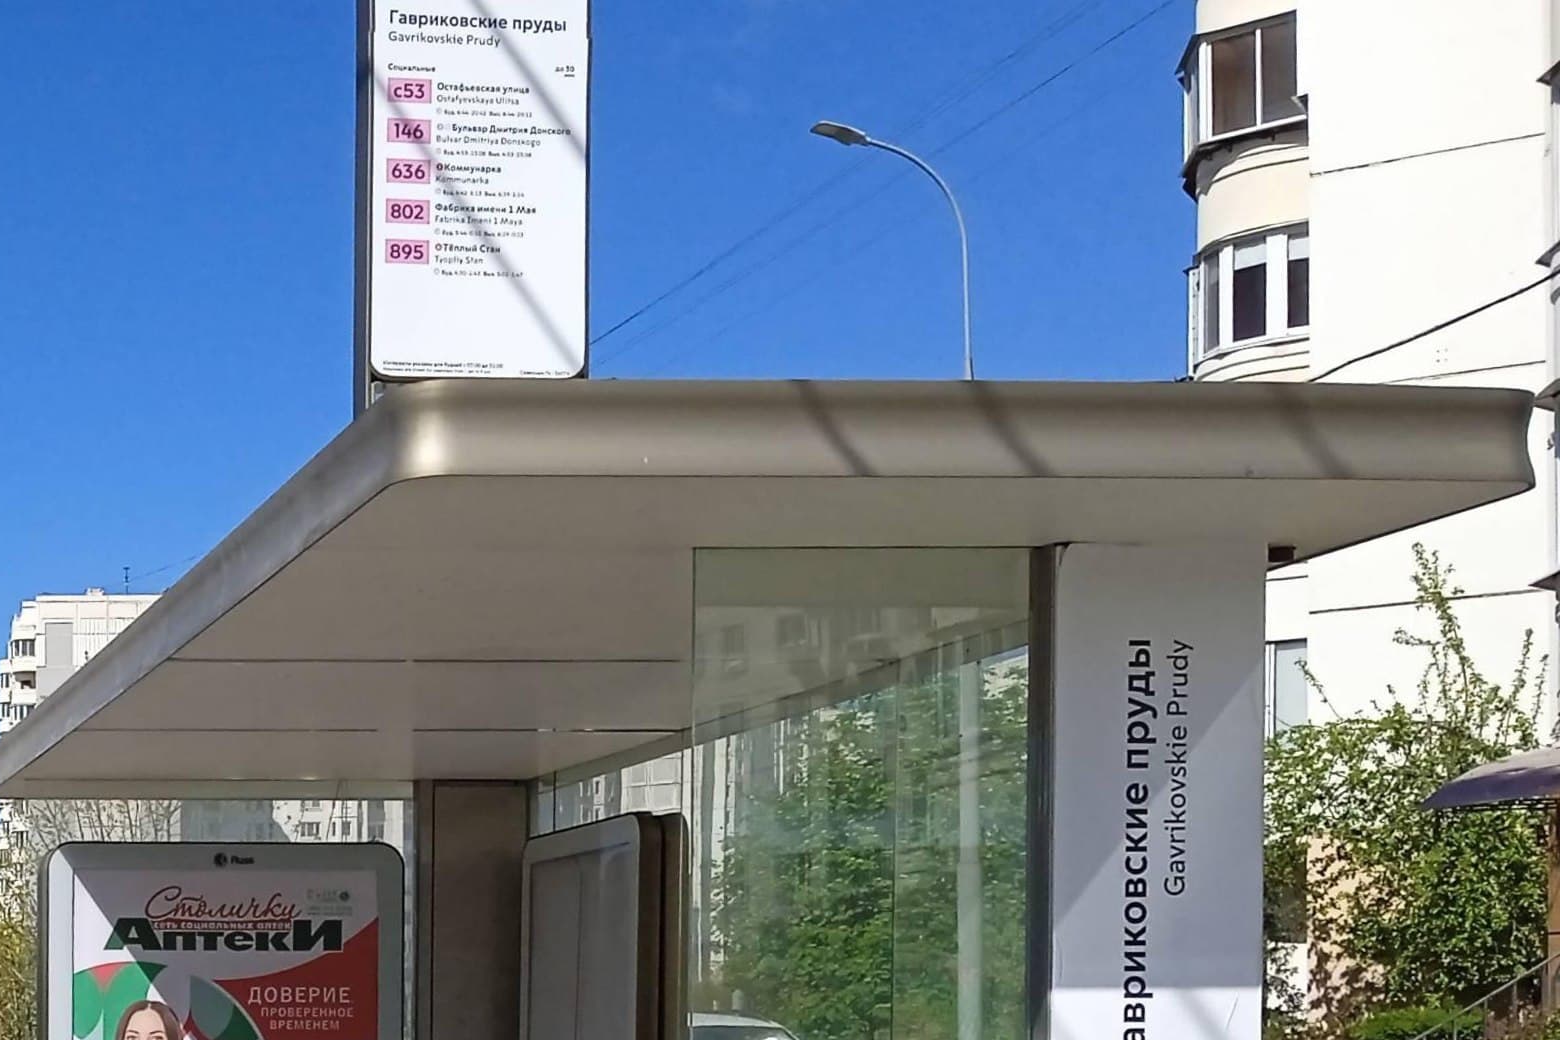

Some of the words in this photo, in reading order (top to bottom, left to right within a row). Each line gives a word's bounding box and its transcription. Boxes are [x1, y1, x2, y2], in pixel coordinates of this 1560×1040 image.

[389, 9, 508, 30] Гавриковские
[512, 18, 567, 34] пруды
[388, 31, 464, 46] Gavrikovskie
[466, 34, 501, 48] Prudy
[394, 122, 424, 140] 146
[391, 163, 426, 180] 636
[444, 163, 502, 175] Коммунарка
[390, 203, 425, 220] 802
[508, 205, 514, 214] 1
[389, 243, 425, 260] 895
[479, 243, 501, 254] Стан
[1166, 639, 1195, 717] Prudy
[1124, 639, 1158, 769] пруды
[1164, 726, 1188, 896] Gavrikovskie
[144, 885, 302, 920] Столички
[153, 920, 178, 930] сеть
[180, 920, 254, 931] социальных
[255, 920, 291, 930] аптек
[248, 986, 351, 1005] ДОВЕРИЕ
[260, 1006, 354, 1019] ПРОВЕРЕННОЕ
[269, 1019, 340, 1031] ВРЕМЕНЕМ
